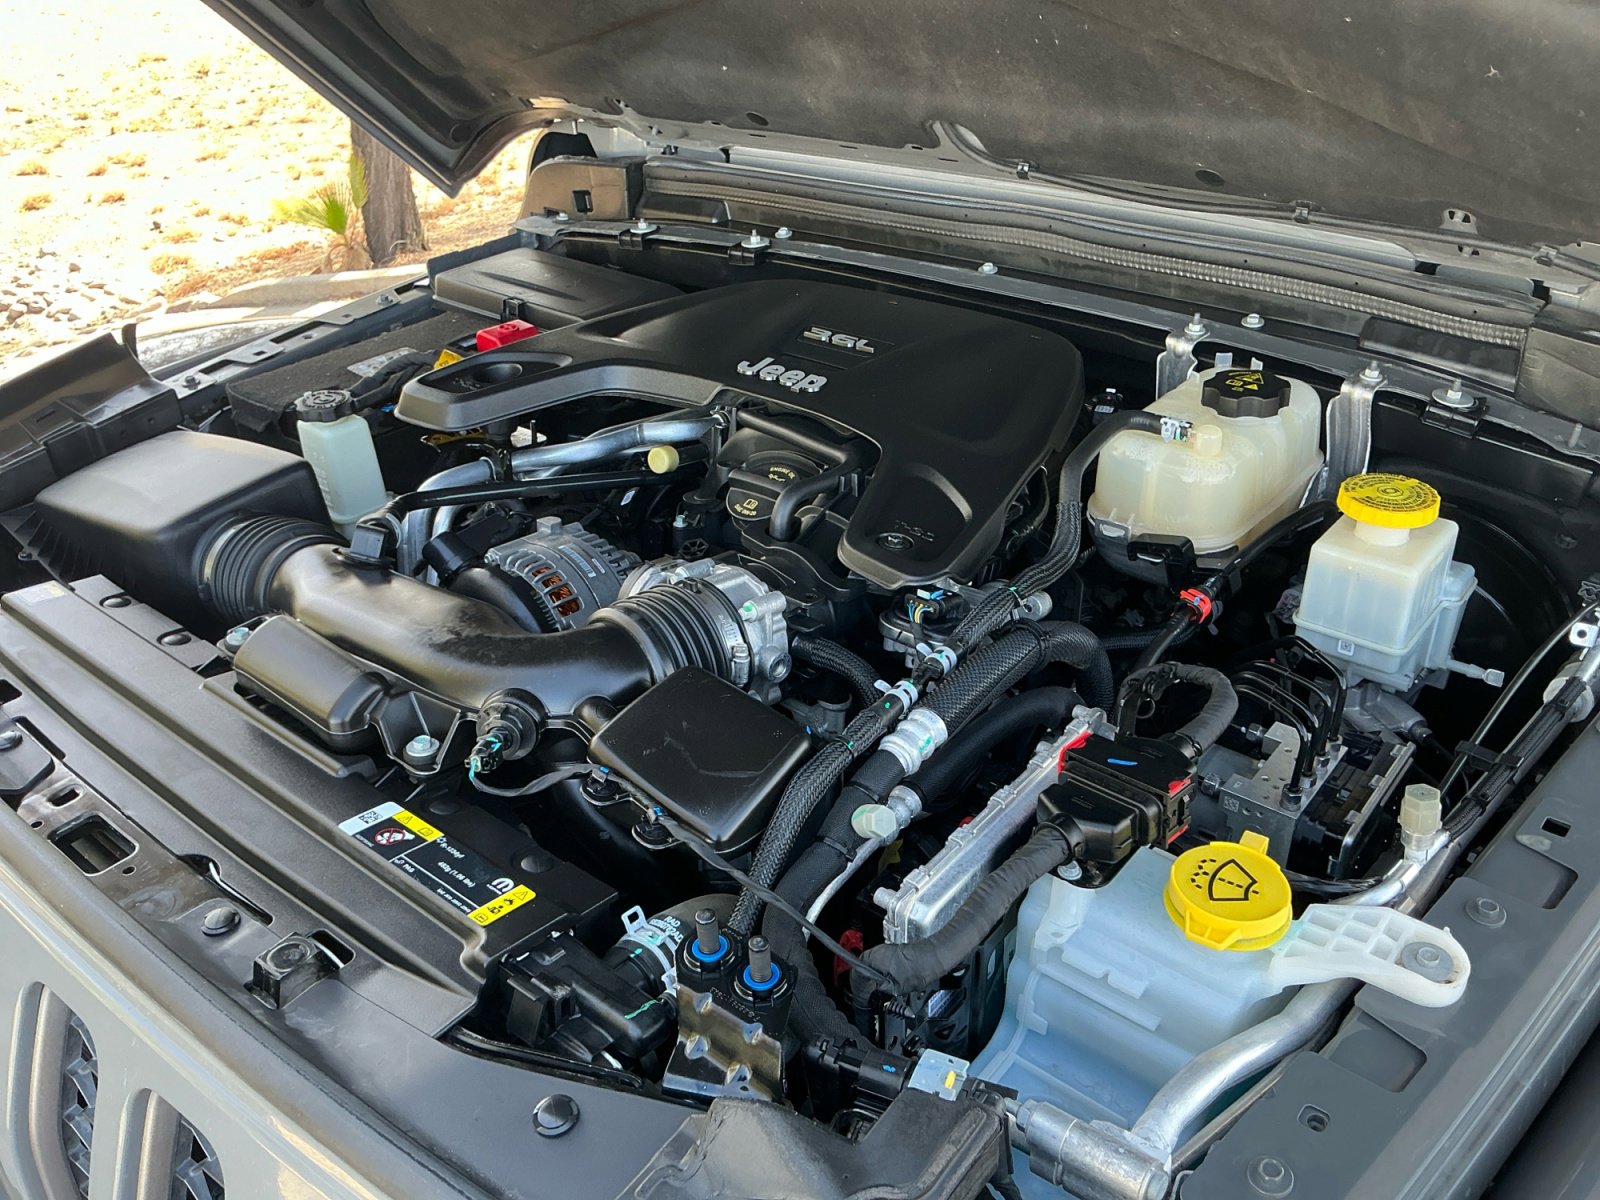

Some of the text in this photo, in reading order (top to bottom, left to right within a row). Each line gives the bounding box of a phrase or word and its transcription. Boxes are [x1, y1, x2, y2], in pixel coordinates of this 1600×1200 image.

[736, 356, 828, 394] Jeep
[770, 466, 796, 480] ENGINE OIL
[664, 916, 681, 927] RAD
